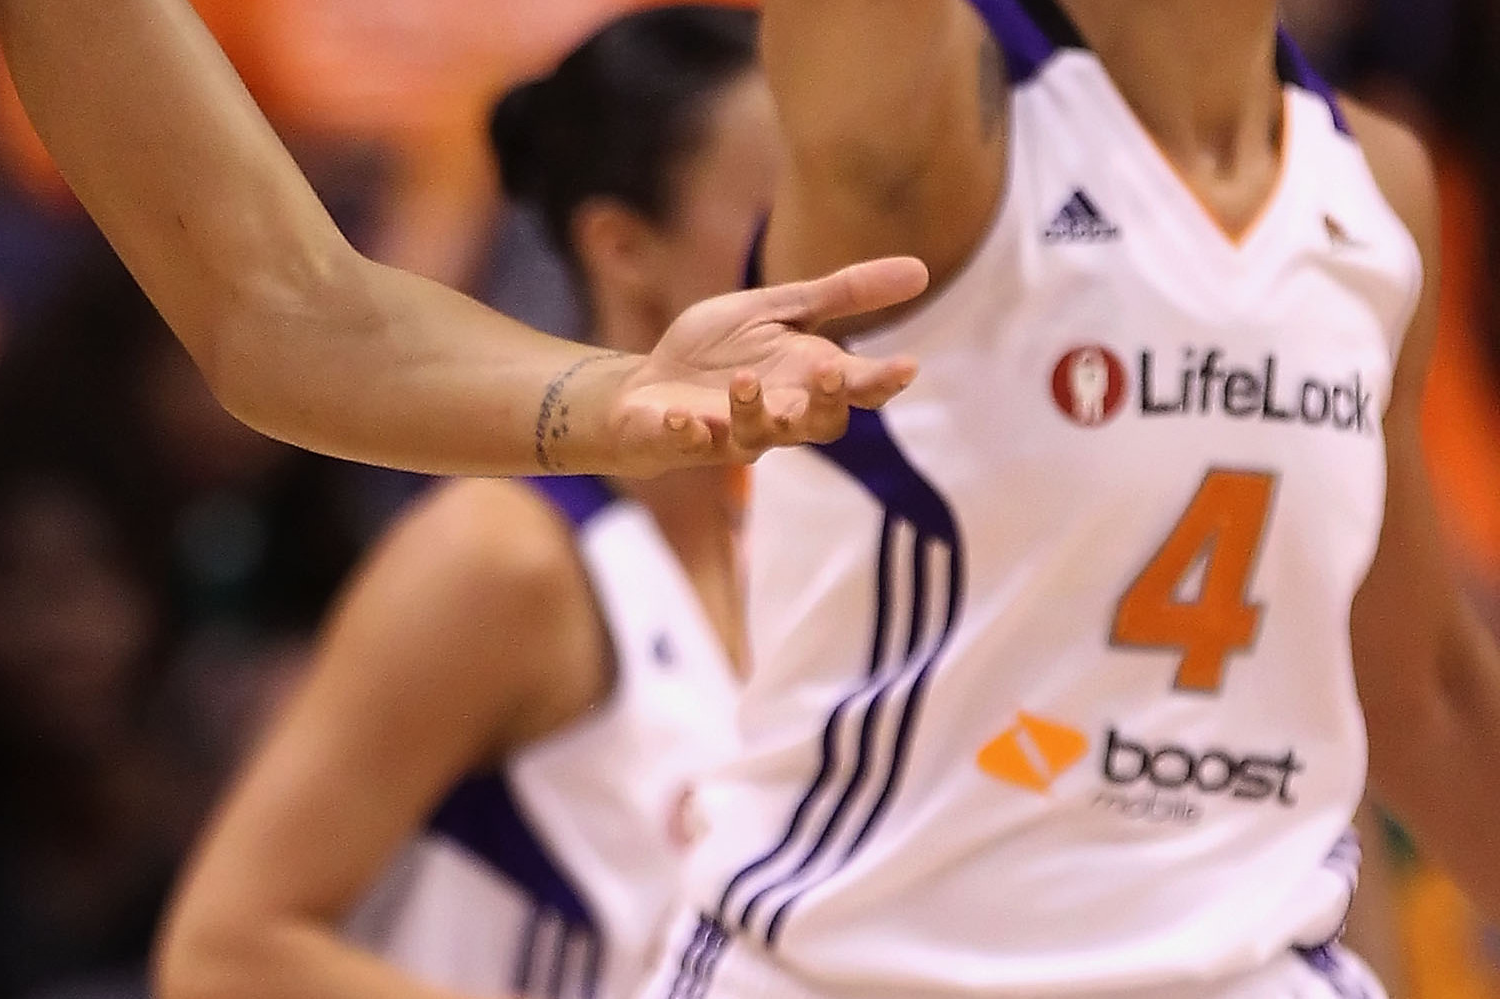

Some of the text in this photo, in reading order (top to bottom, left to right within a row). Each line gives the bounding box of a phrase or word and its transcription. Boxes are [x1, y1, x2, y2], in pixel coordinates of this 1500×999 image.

[1138, 350, 1373, 434] LifeLock
[1109, 467, 1280, 693] 4
[1103, 727, 1304, 806] boost
